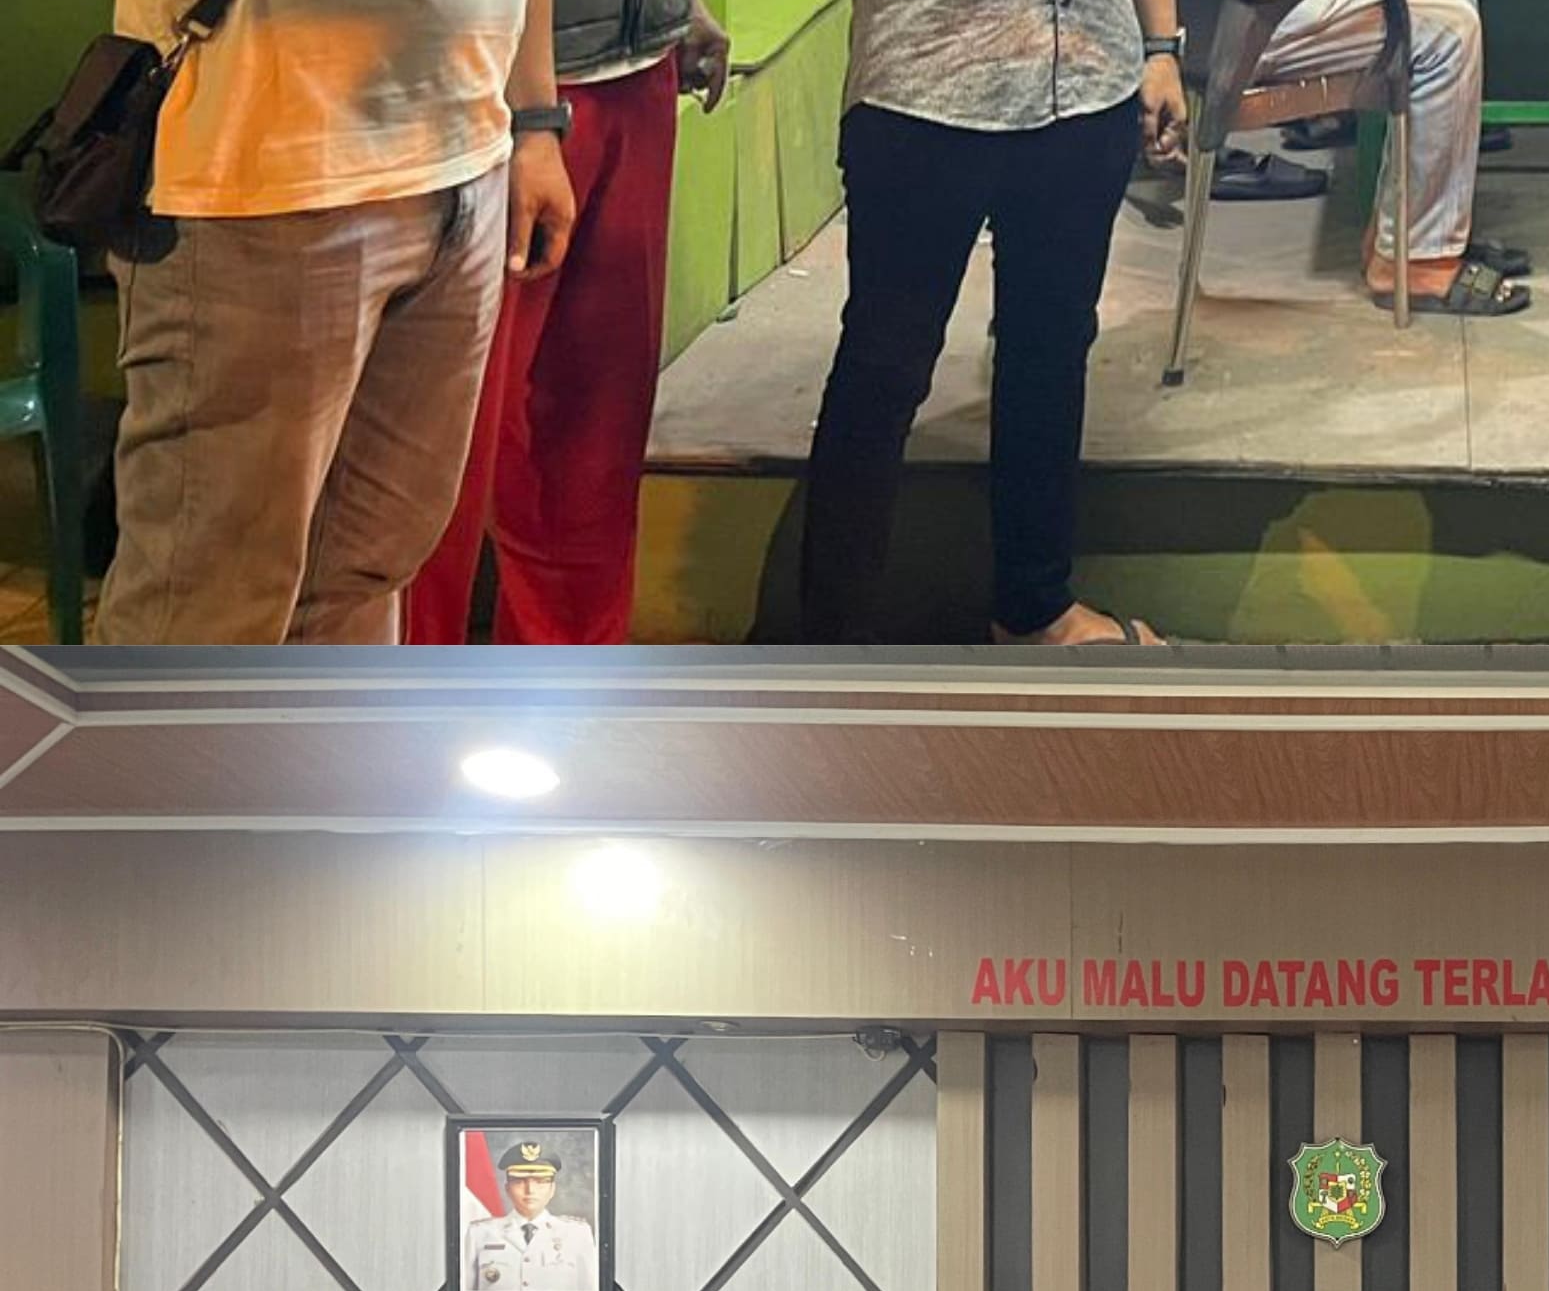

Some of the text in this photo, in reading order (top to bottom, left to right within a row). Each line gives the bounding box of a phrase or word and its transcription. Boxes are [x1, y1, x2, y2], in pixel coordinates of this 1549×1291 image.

[970, 957, 1067, 1006] AKU
[1083, 958, 1206, 1007] MALU
[1223, 959, 1399, 1008] DATANG
